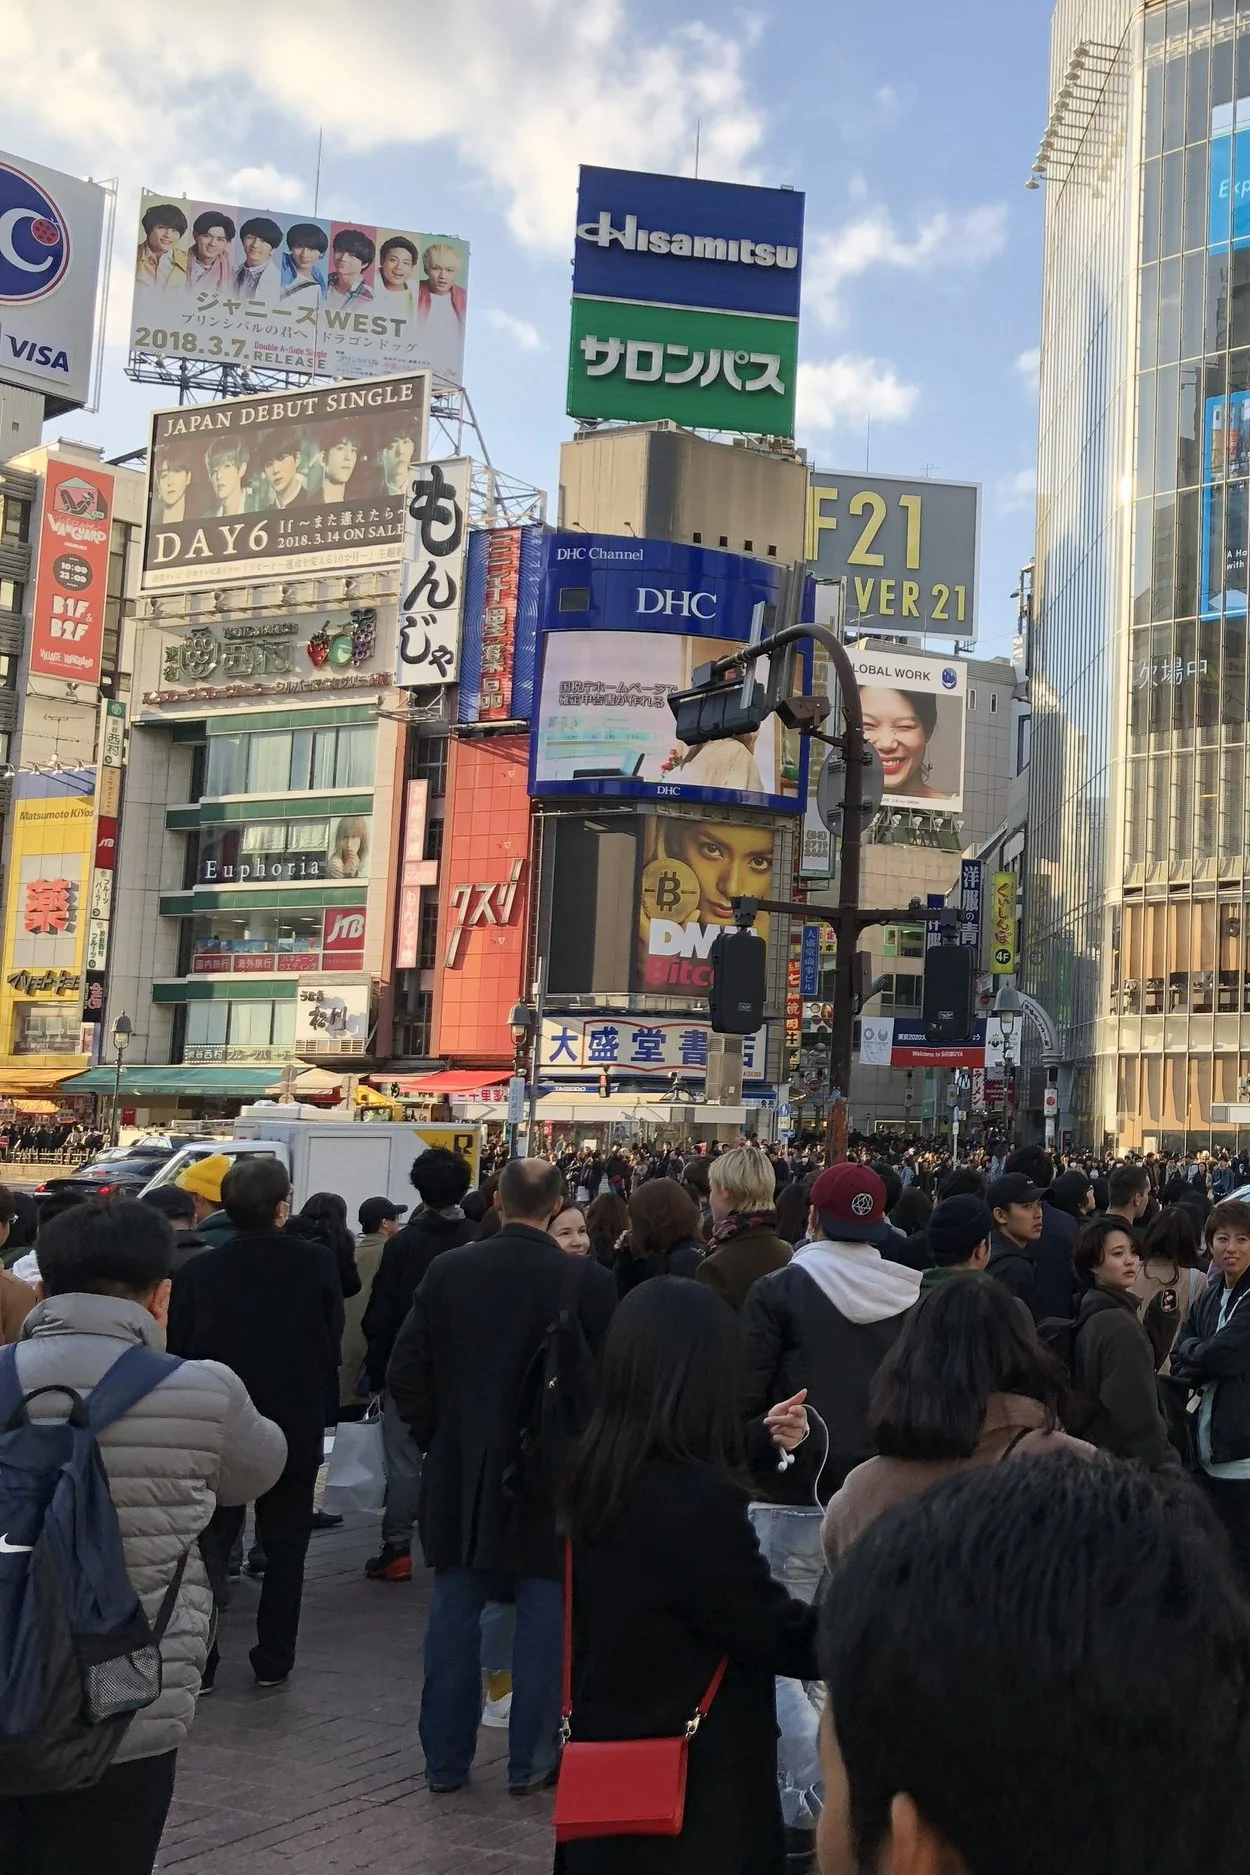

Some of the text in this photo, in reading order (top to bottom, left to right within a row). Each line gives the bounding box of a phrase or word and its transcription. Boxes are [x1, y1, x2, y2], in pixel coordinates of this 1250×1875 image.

[577, 211, 799, 269] Hisamitsu
[6, 334, 70, 373] VISA
[254, 341, 279, 353] Double
[254, 351, 326, 370] RELEASE
[580, 334, 786, 396] サロンパス
[164, 383, 414, 437] JAPAN DEBUT SINGLE
[153, 520, 269, 563] DAY6
[278, 522, 405, 549] 2018.3.14 ON SALE
[556, 547, 644, 562] DHC Channel
[1227, 550, 1233, 558] A
[1227, 561, 1245, 571] with
[400, 464, 464, 678] もんじゃ
[53, 594, 90, 618] B1F
[636, 587, 718, 620] DHC
[931, 582, 967, 622] 21
[50, 617, 89, 642] B2F
[479, 534, 514, 712] 三千里薬品
[853, 664, 930, 681] LOBAL WORK
[656, 785, 681, 796] DHC
[19, 808, 94, 821] Matsumoto KiYos
[98, 837, 115, 848] JTB
[204, 857, 320, 882] Euphoria
[24, 878, 72, 935] 薬
[960, 865, 980, 946] 洋服の青
[327, 913, 365, 943] JTB
[645, 956, 714, 986] Bitc
[995, 952, 1010, 962] 4F
[972, 1070, 985, 1105] ラーメン
